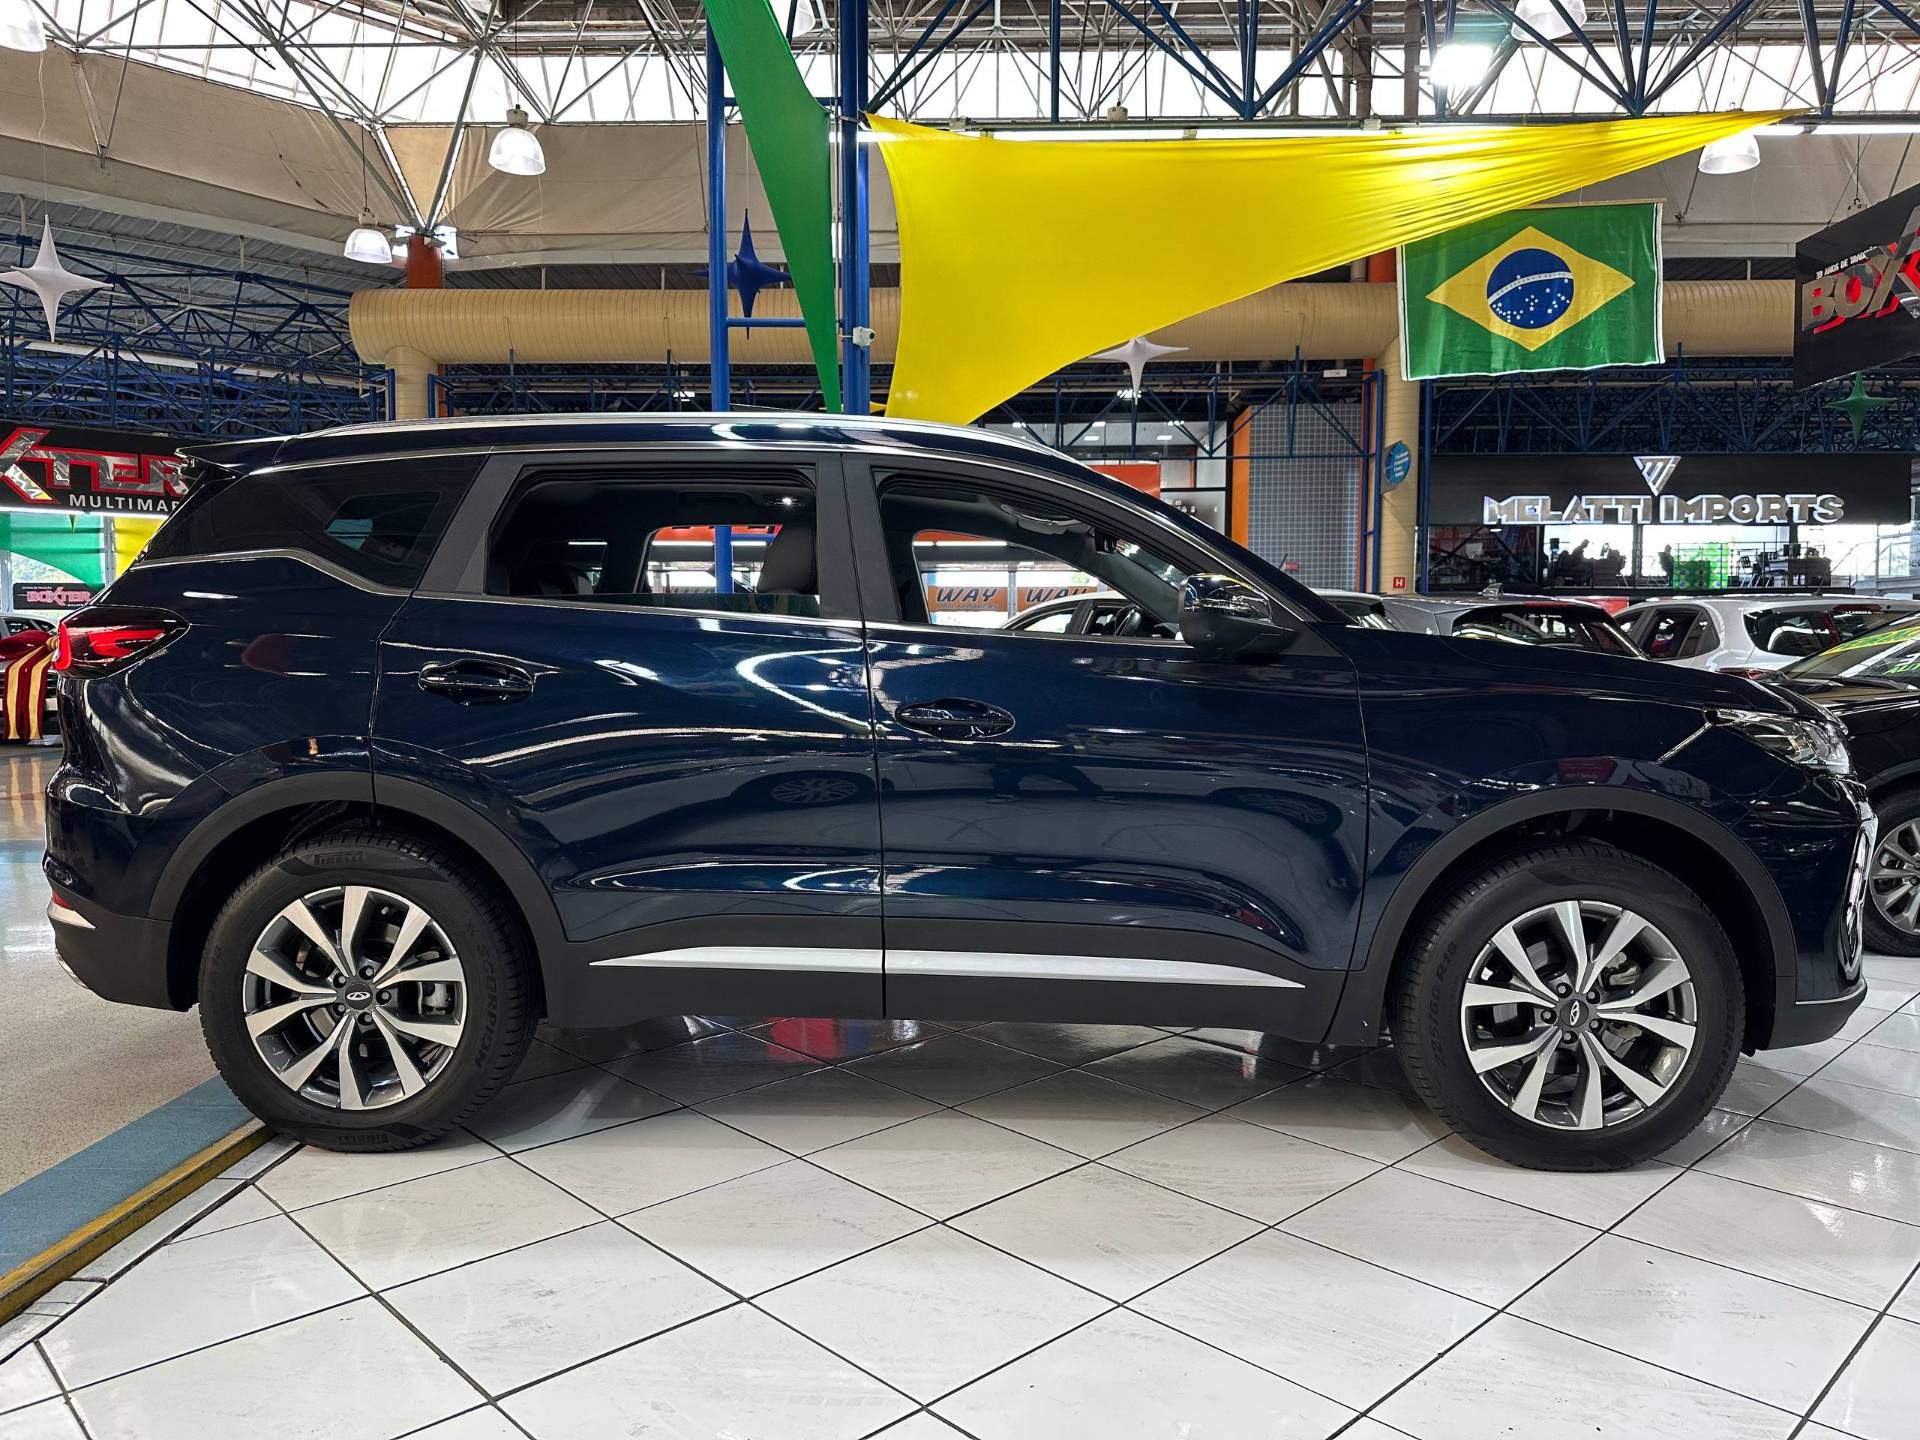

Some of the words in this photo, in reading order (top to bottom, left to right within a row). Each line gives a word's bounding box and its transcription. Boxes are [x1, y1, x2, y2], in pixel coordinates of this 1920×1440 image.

[1483, 496, 1652, 525] MELATTI
[1659, 494, 1845, 524] IMPORTS
[936, 588, 997, 602] WAY
